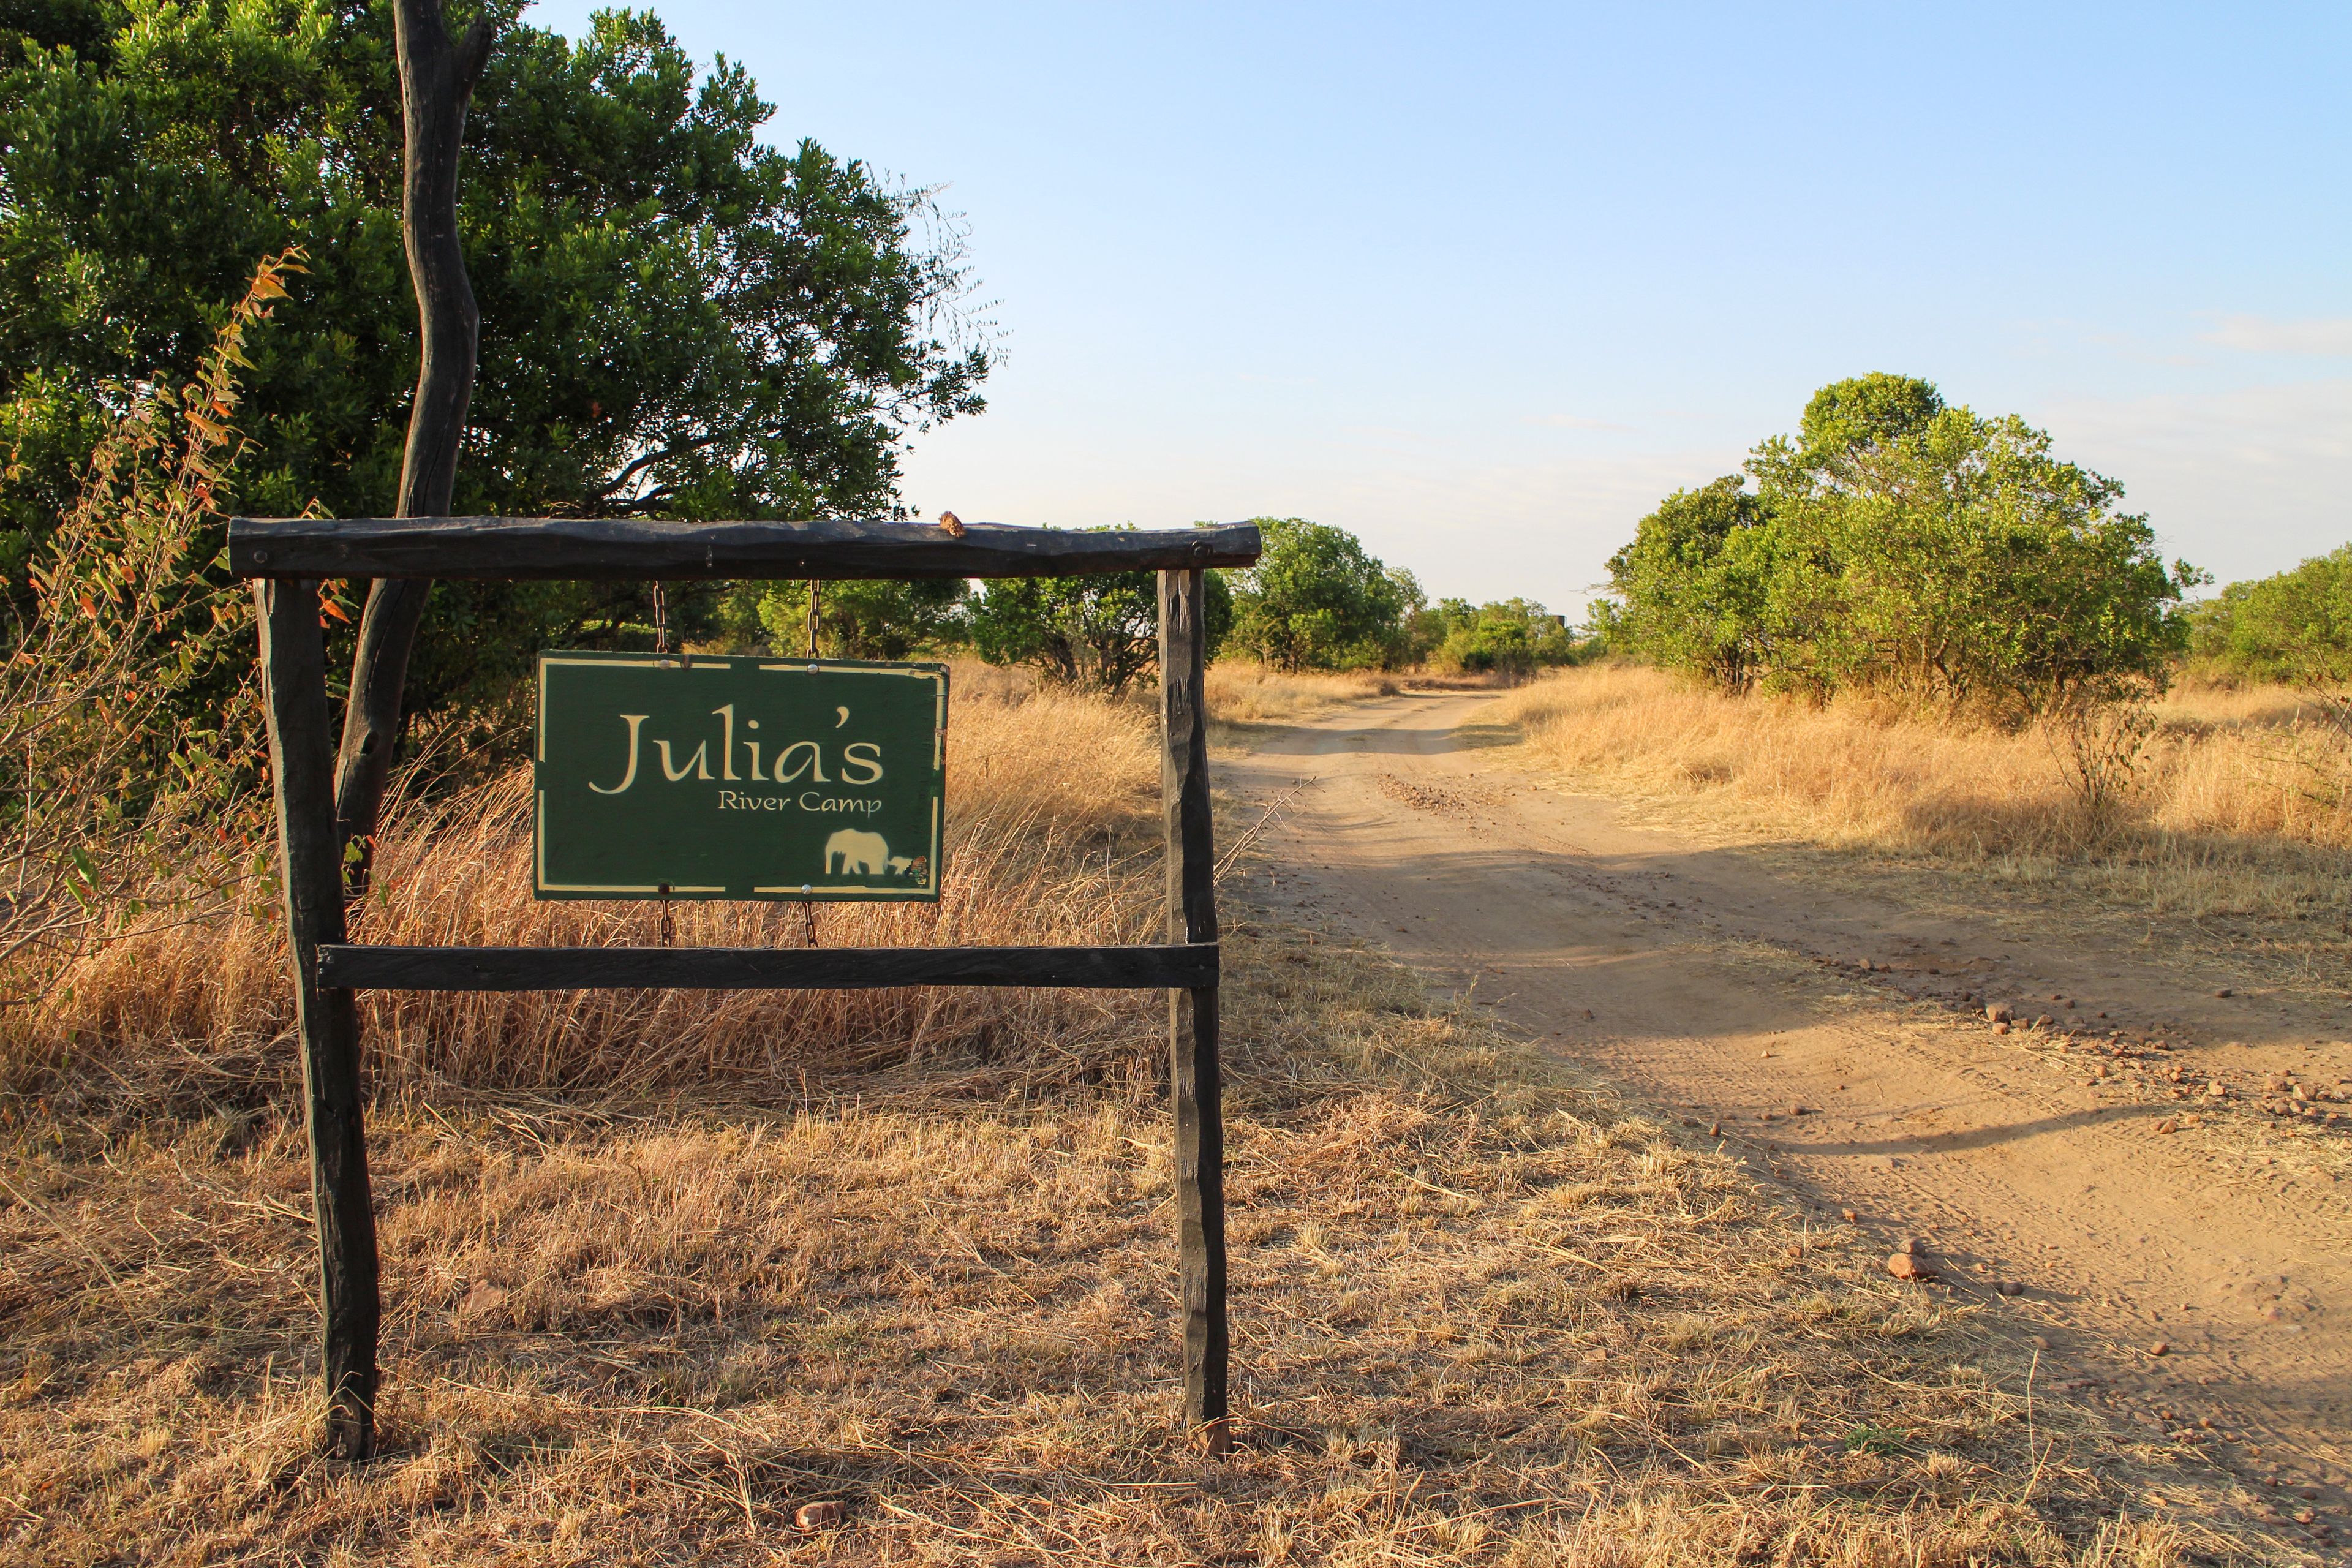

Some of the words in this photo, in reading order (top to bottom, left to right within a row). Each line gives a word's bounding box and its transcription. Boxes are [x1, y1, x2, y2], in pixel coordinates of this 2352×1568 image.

[589, 703, 884, 794] Julia's
[718, 790, 791, 811] River
[799, 791, 883, 819] Camp
